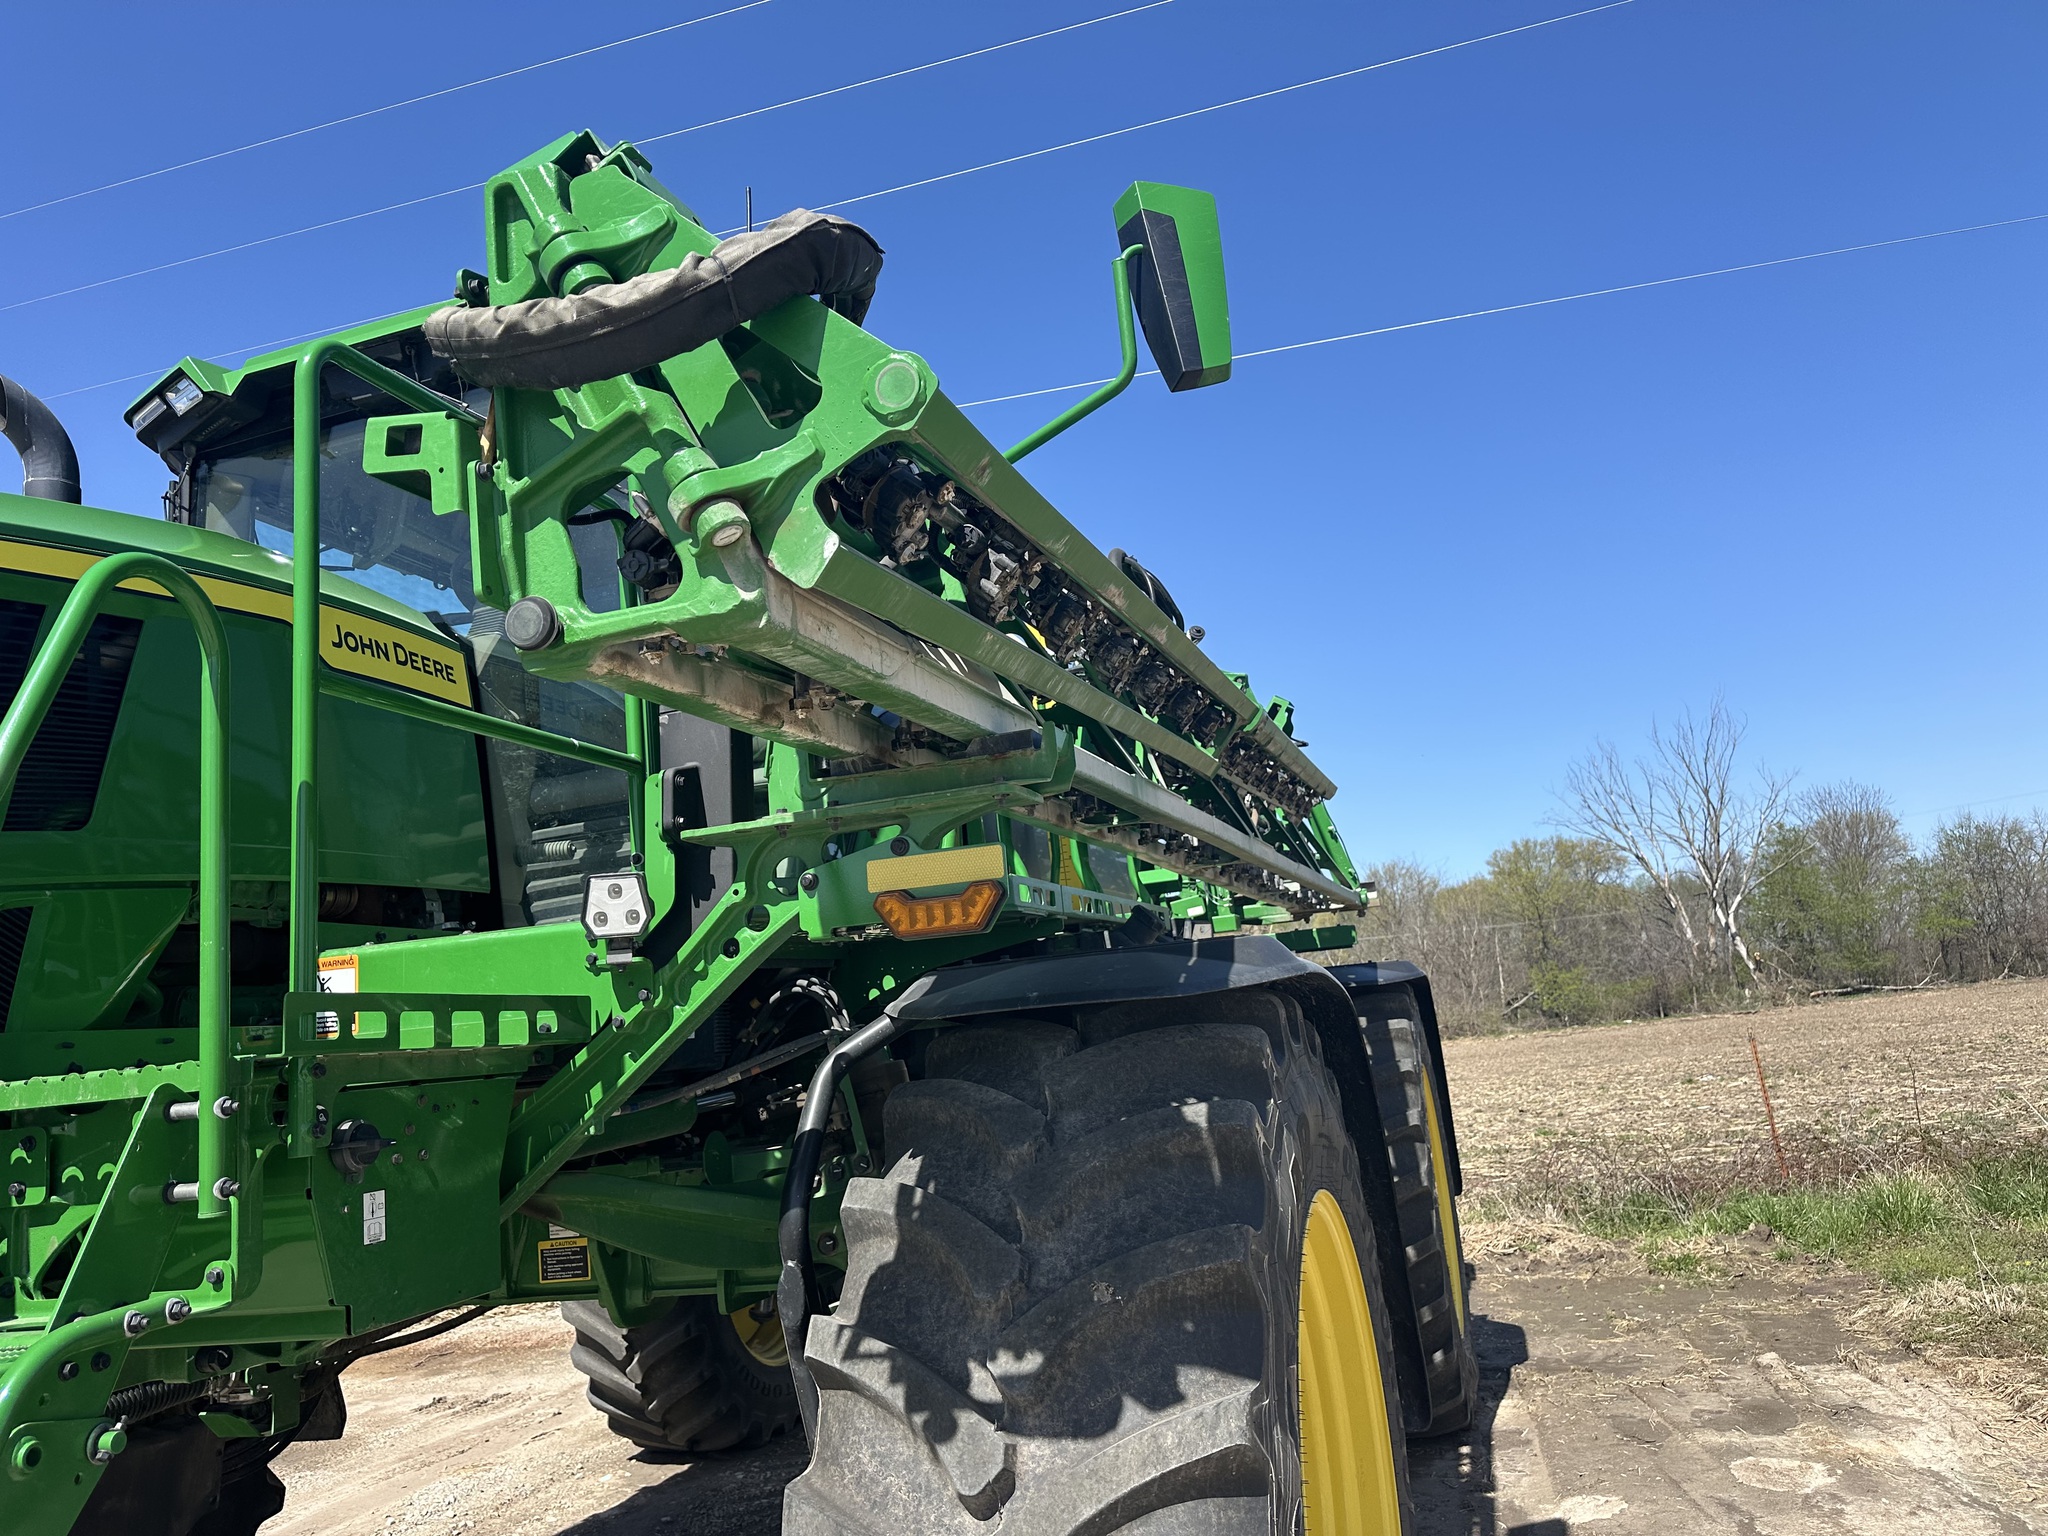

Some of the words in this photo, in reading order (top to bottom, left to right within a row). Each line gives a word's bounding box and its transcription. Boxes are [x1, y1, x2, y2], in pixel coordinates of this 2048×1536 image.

[331, 623, 391, 662] JOHN
[392, 641, 457, 684] DEERE
[322, 960, 354, 968] WARNING
